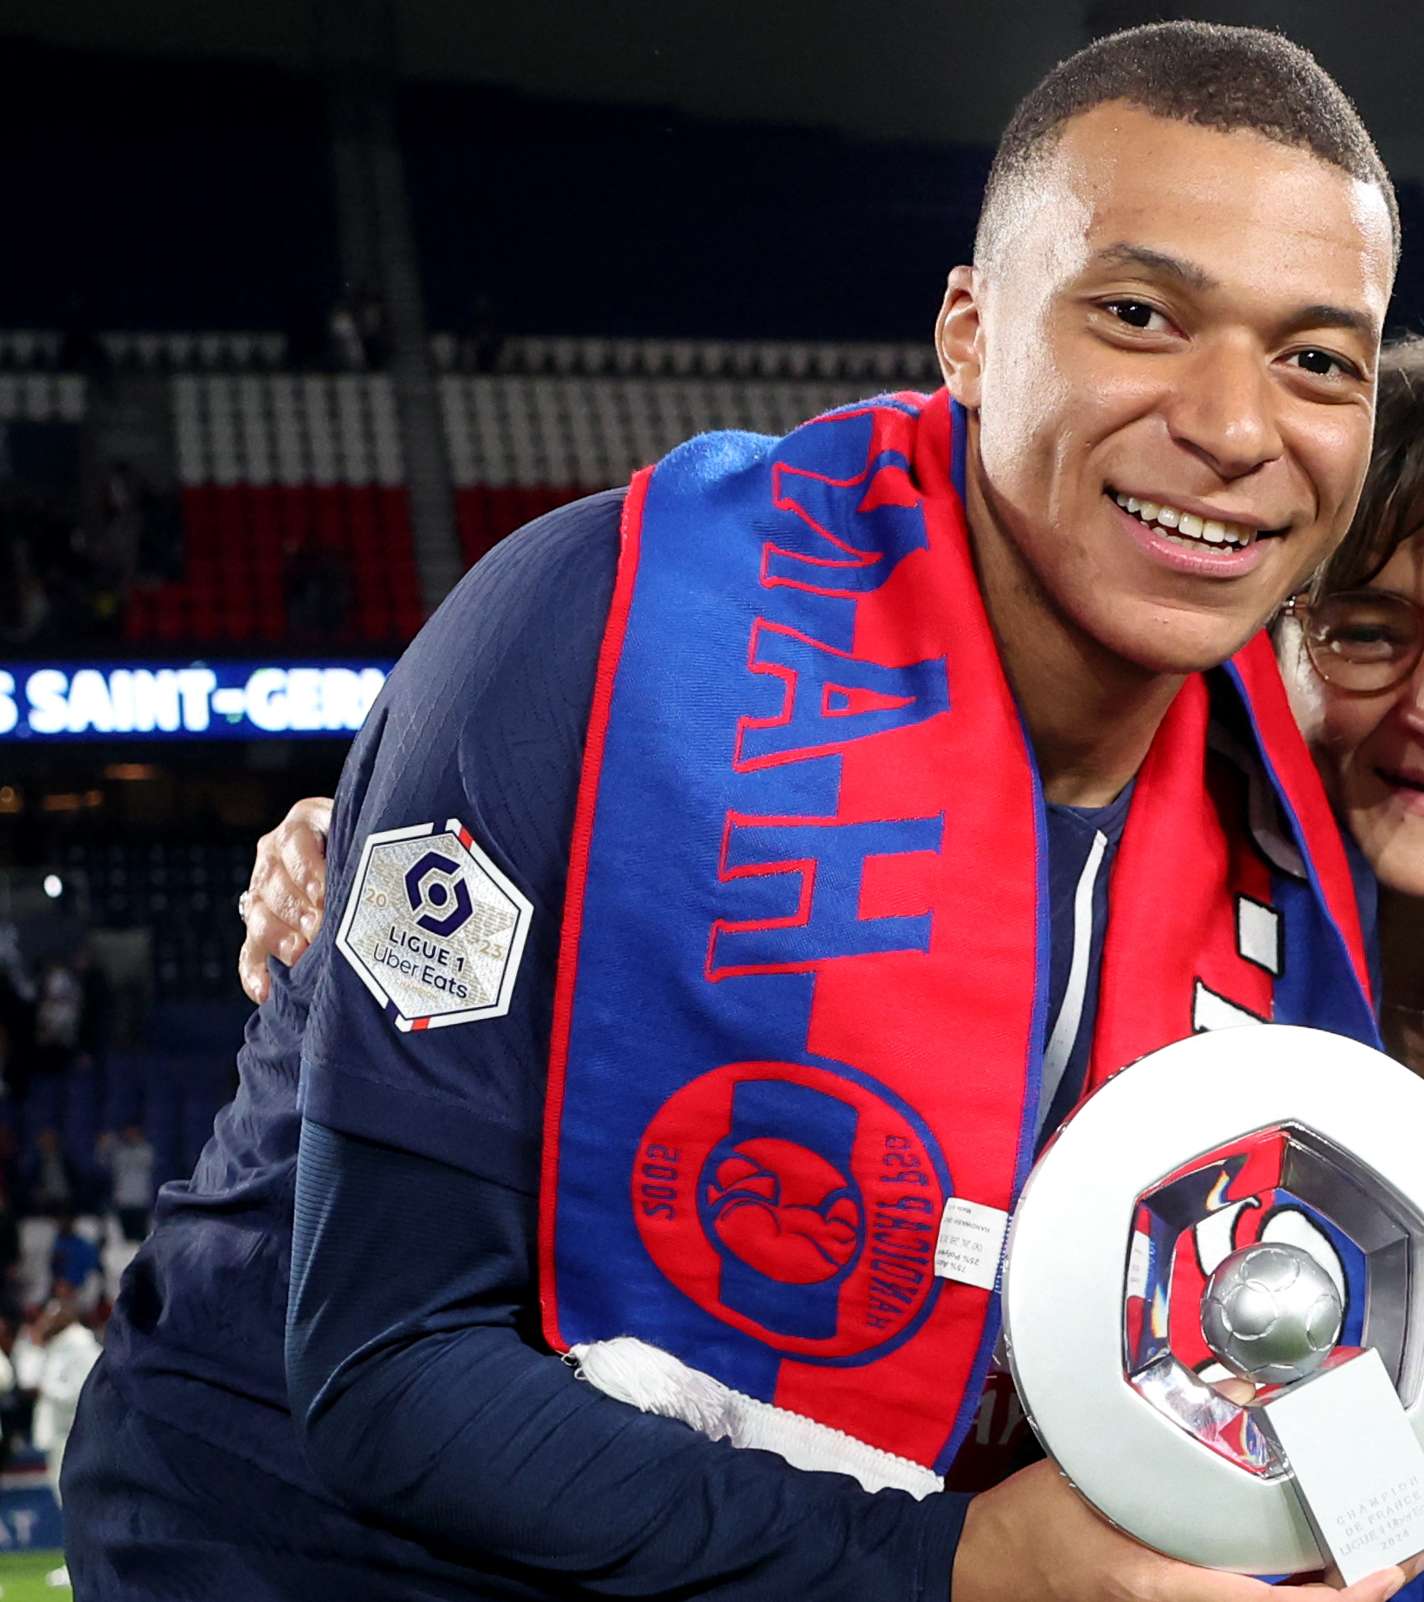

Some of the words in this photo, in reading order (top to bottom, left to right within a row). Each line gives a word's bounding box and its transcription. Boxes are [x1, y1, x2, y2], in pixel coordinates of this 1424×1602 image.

[365, 888, 387, 908] 20
[373, 942, 419, 978] Uber
[421, 966, 469, 999] Eats
[389, 926, 450, 966] LIGUE
[456, 957, 465, 972] 1
[480, 939, 504, 959] 23
[1336, 1475, 1418, 1526] CHAMPION
[1345, 1521, 1363, 1537] DE
[1368, 1489, 1421, 1525] FRANCE
[1380, 1528, 1410, 1551] 2024
